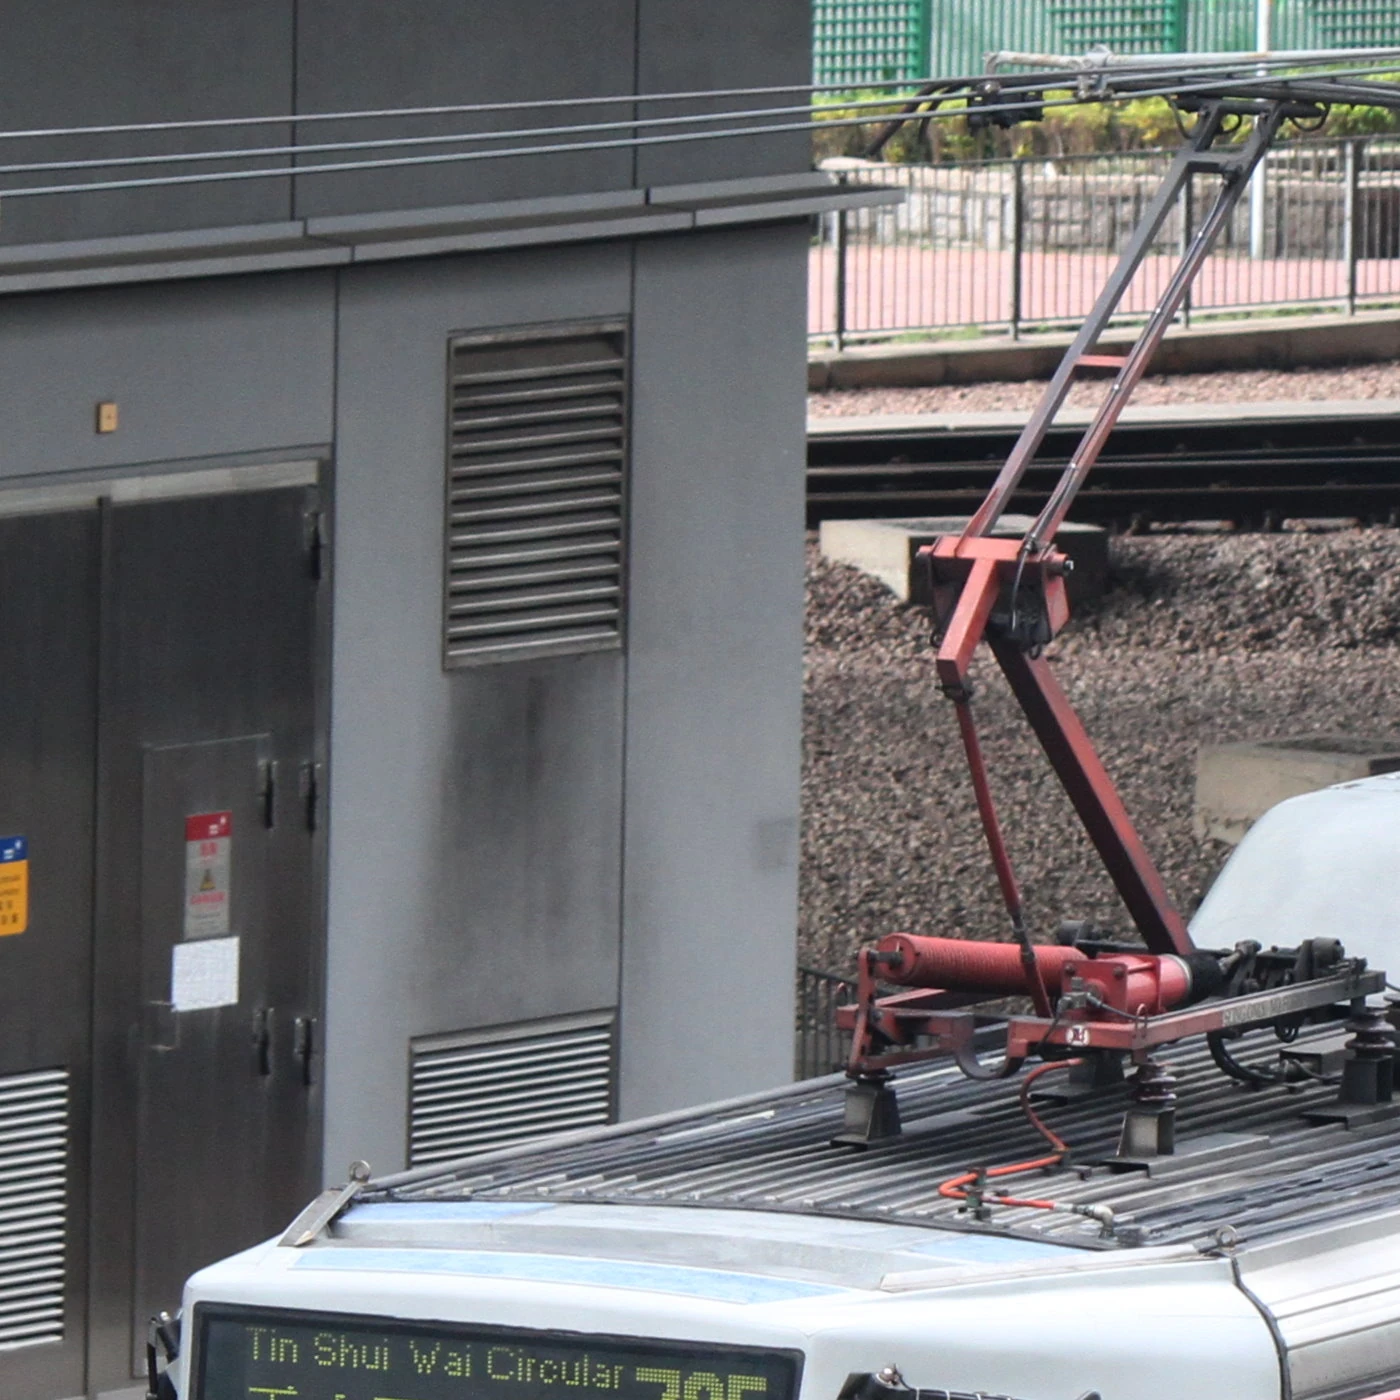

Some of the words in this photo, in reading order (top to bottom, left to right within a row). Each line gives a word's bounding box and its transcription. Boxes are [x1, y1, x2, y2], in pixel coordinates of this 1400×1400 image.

[246, 1327, 300, 1364] Tin
[314, 1332, 390, 1371] Shui
[409, 1339, 474, 1378] Wai
[488, 1344, 627, 1390] Circular
